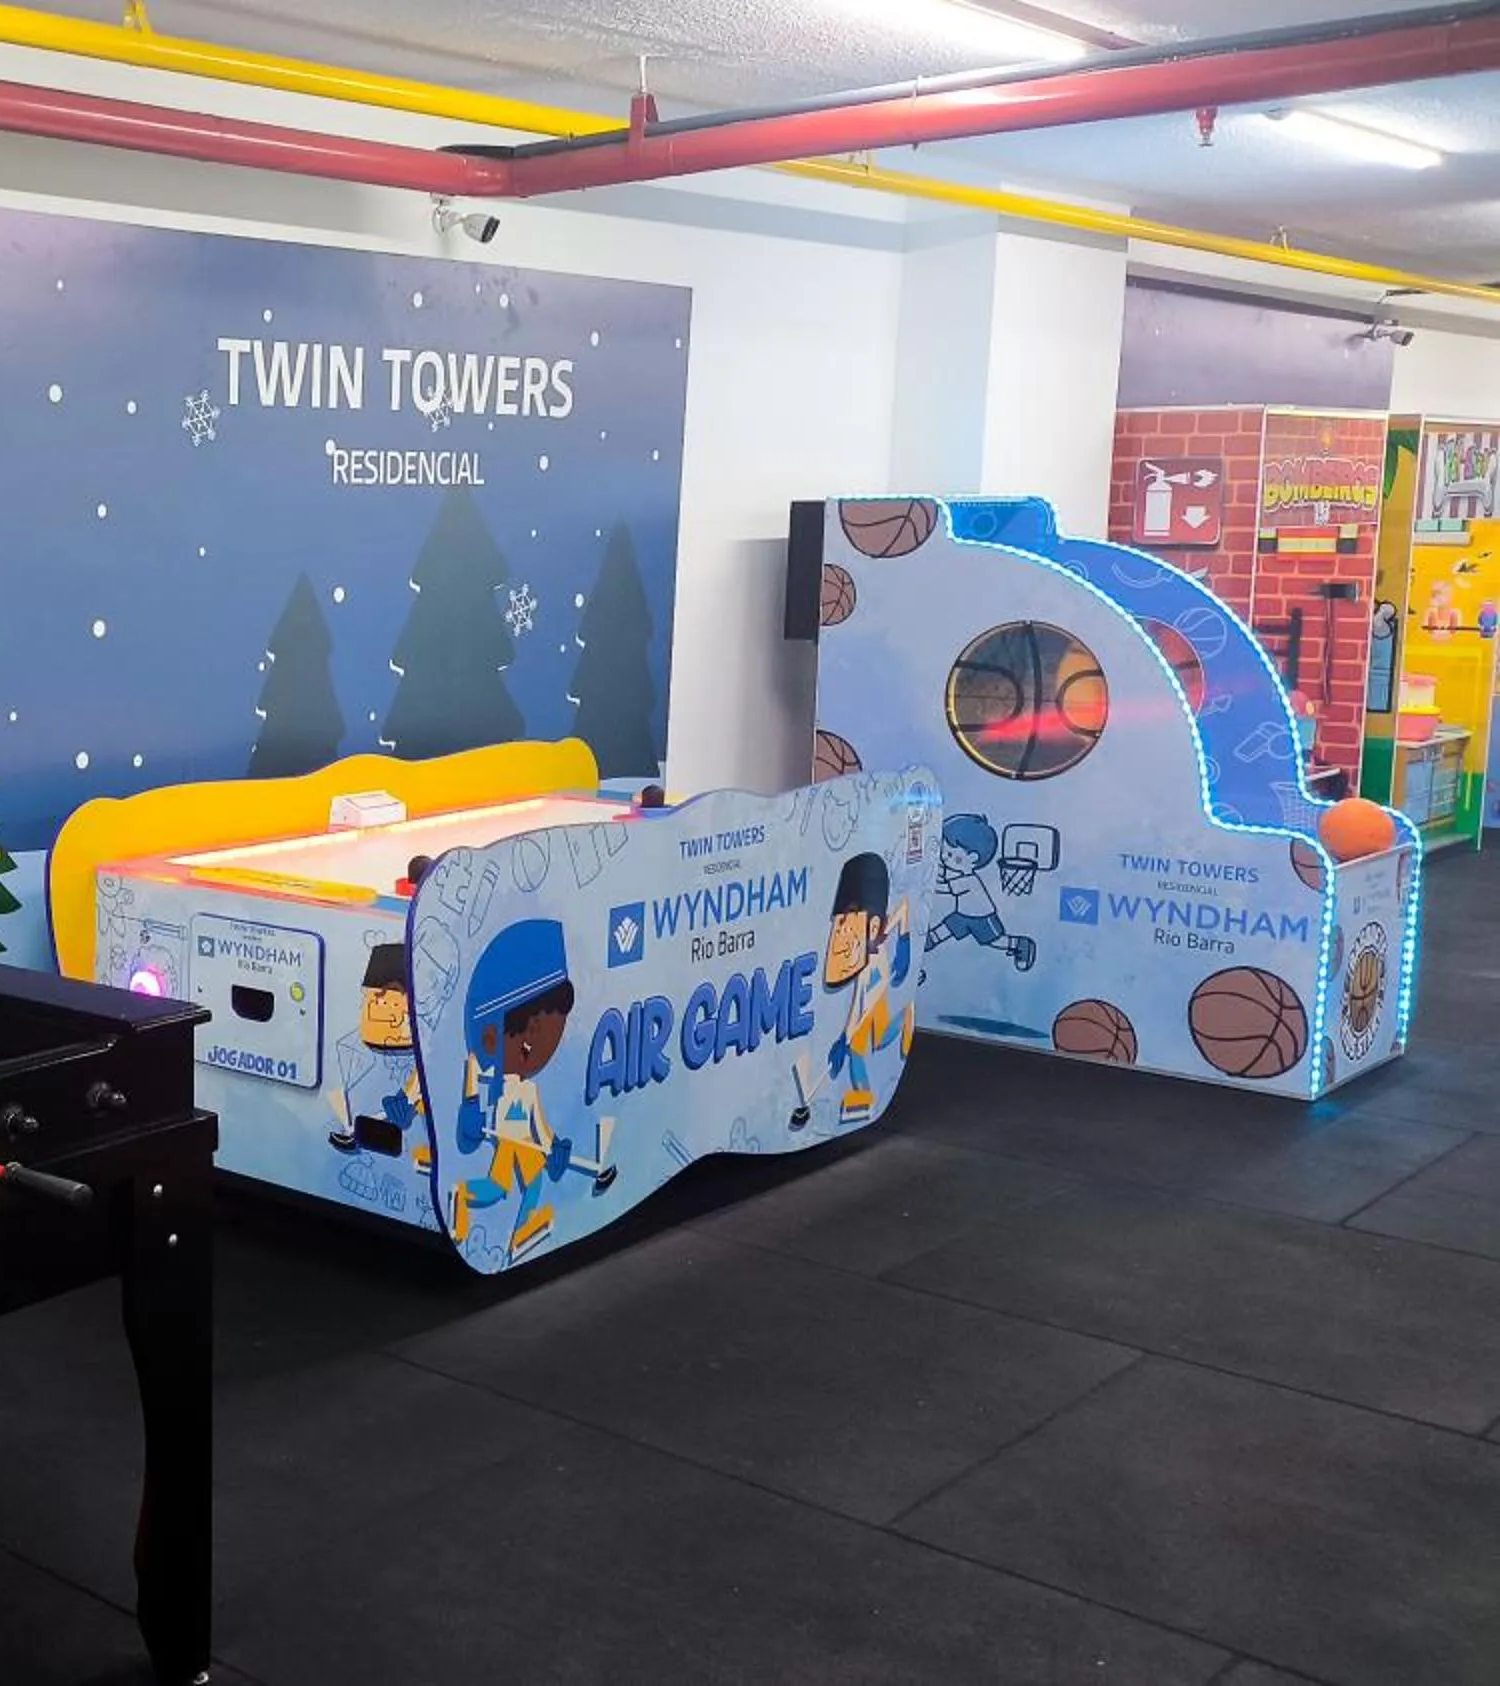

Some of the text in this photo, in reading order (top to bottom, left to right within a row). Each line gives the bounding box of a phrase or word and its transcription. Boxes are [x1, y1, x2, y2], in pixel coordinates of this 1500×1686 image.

[217, 337, 574, 418] TWIN TOWERS
[332, 448, 485, 486] RESIDENCIAL
[679, 825, 766, 860] TWIN TOWERS
[1119, 853, 1260, 883] TWIN TOWERS
[653, 865, 808, 940] WYNDHAM
[1107, 892, 1311, 943] WYNDHAM
[217, 938, 302, 967] WYNDHAM
[691, 929, 756, 963] Rio Barra
[1154, 927, 1236, 955] Rio Barra
[585, 951, 818, 1106] AIR GAME
[207, 1045, 297, 1080] JOGADOR 01
